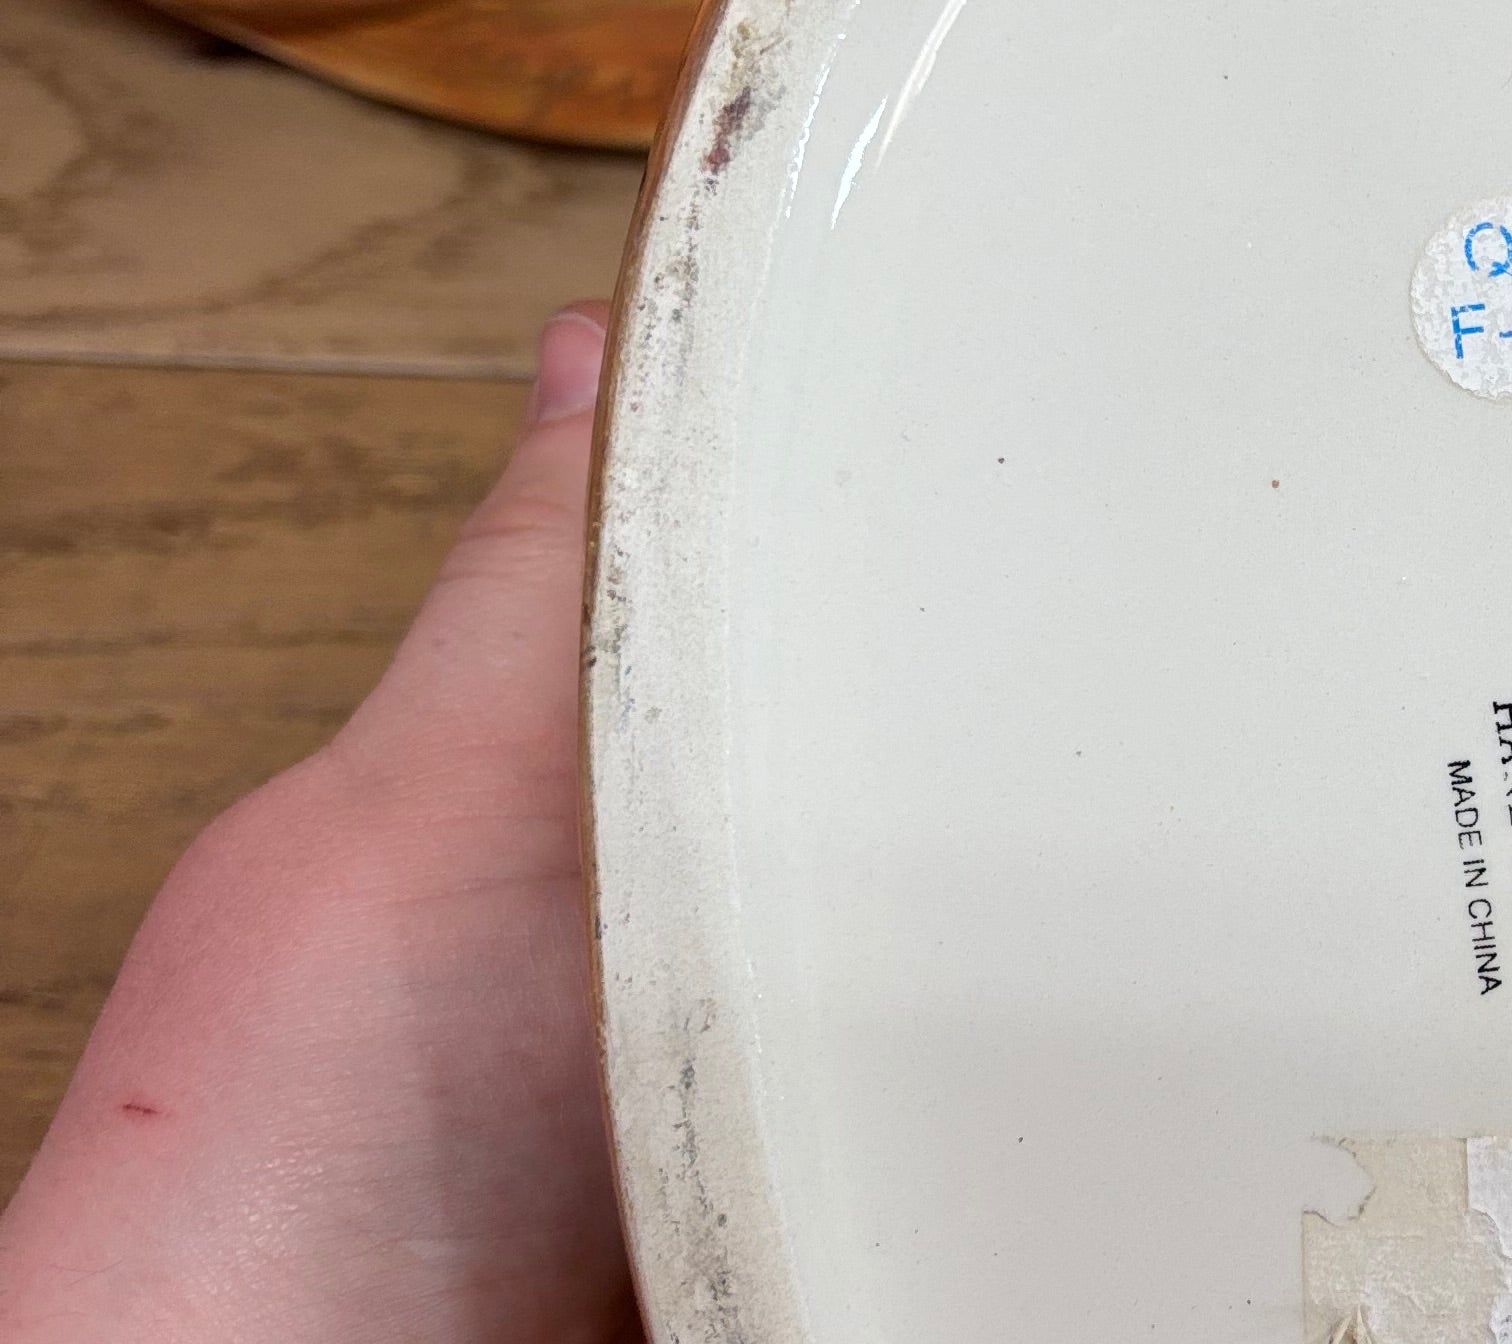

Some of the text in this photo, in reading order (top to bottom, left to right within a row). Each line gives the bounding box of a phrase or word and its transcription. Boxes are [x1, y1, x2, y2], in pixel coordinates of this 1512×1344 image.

[1447, 759, 1503, 996] MADE IN CHINA
